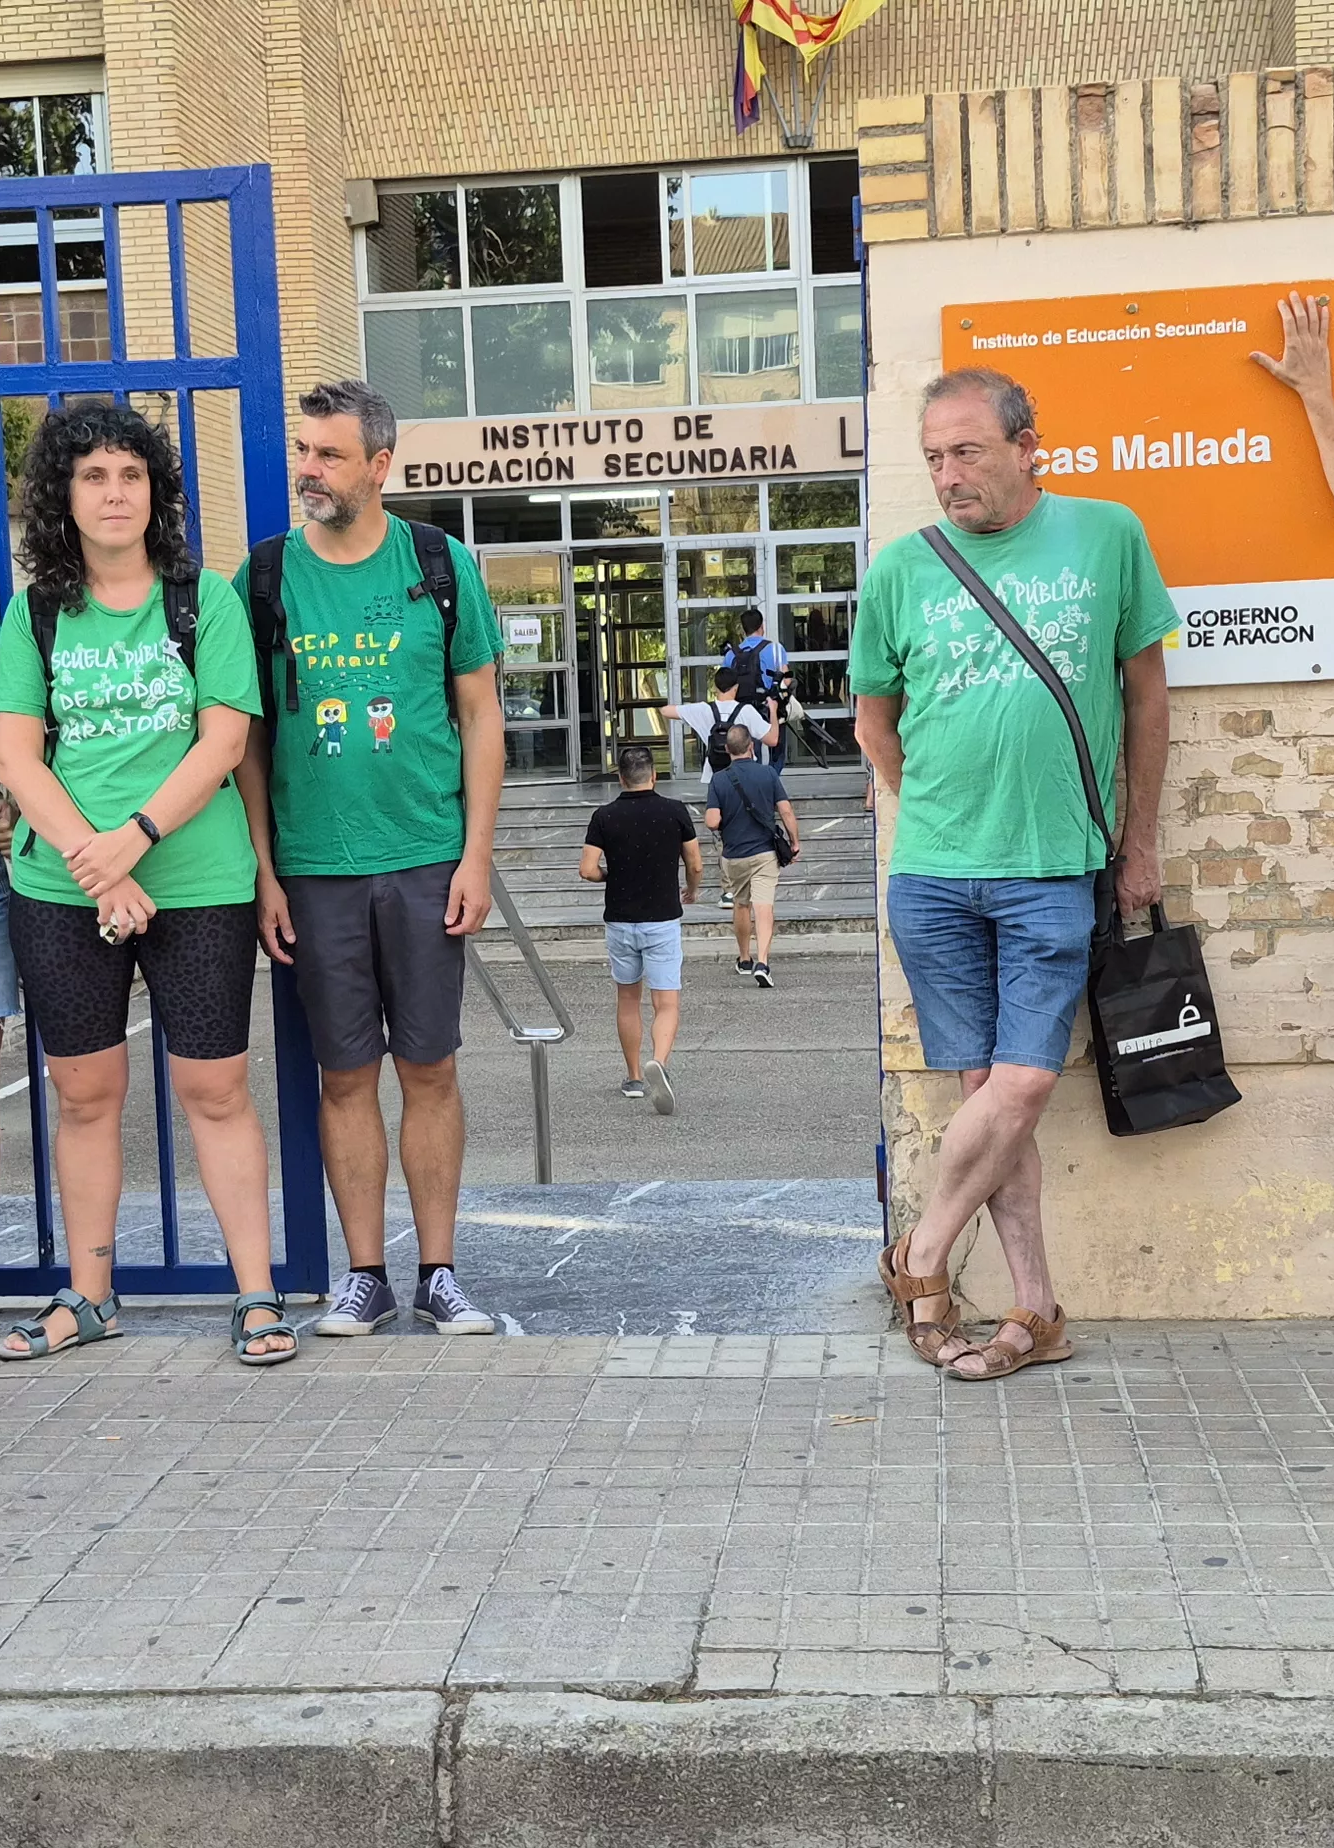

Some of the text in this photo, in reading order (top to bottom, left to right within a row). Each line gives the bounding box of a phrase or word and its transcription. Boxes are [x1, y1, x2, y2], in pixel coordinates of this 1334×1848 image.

[972, 318, 1248, 350] Instituto de Educación Secundaria
[482, 418, 644, 451] INSTITUTO
[674, 414, 714, 441] DE
[405, 444, 798, 489] EDUCACIÓN SECUNDARIA
[1032, 428, 1272, 477] cas Mallada
[1186, 605, 1299, 629] GOBIERNO
[947, 620, 1079, 660] DE TD@S
[1187, 625, 1315, 648] DE ARAGON
[51, 647, 119, 670] SCUELA
[307, 653, 389, 670] PARQUE
[1008, 660, 1087, 683] TO@S
[59, 677, 185, 711] DE TOD@S
[121, 713, 193, 735] TOD@S
